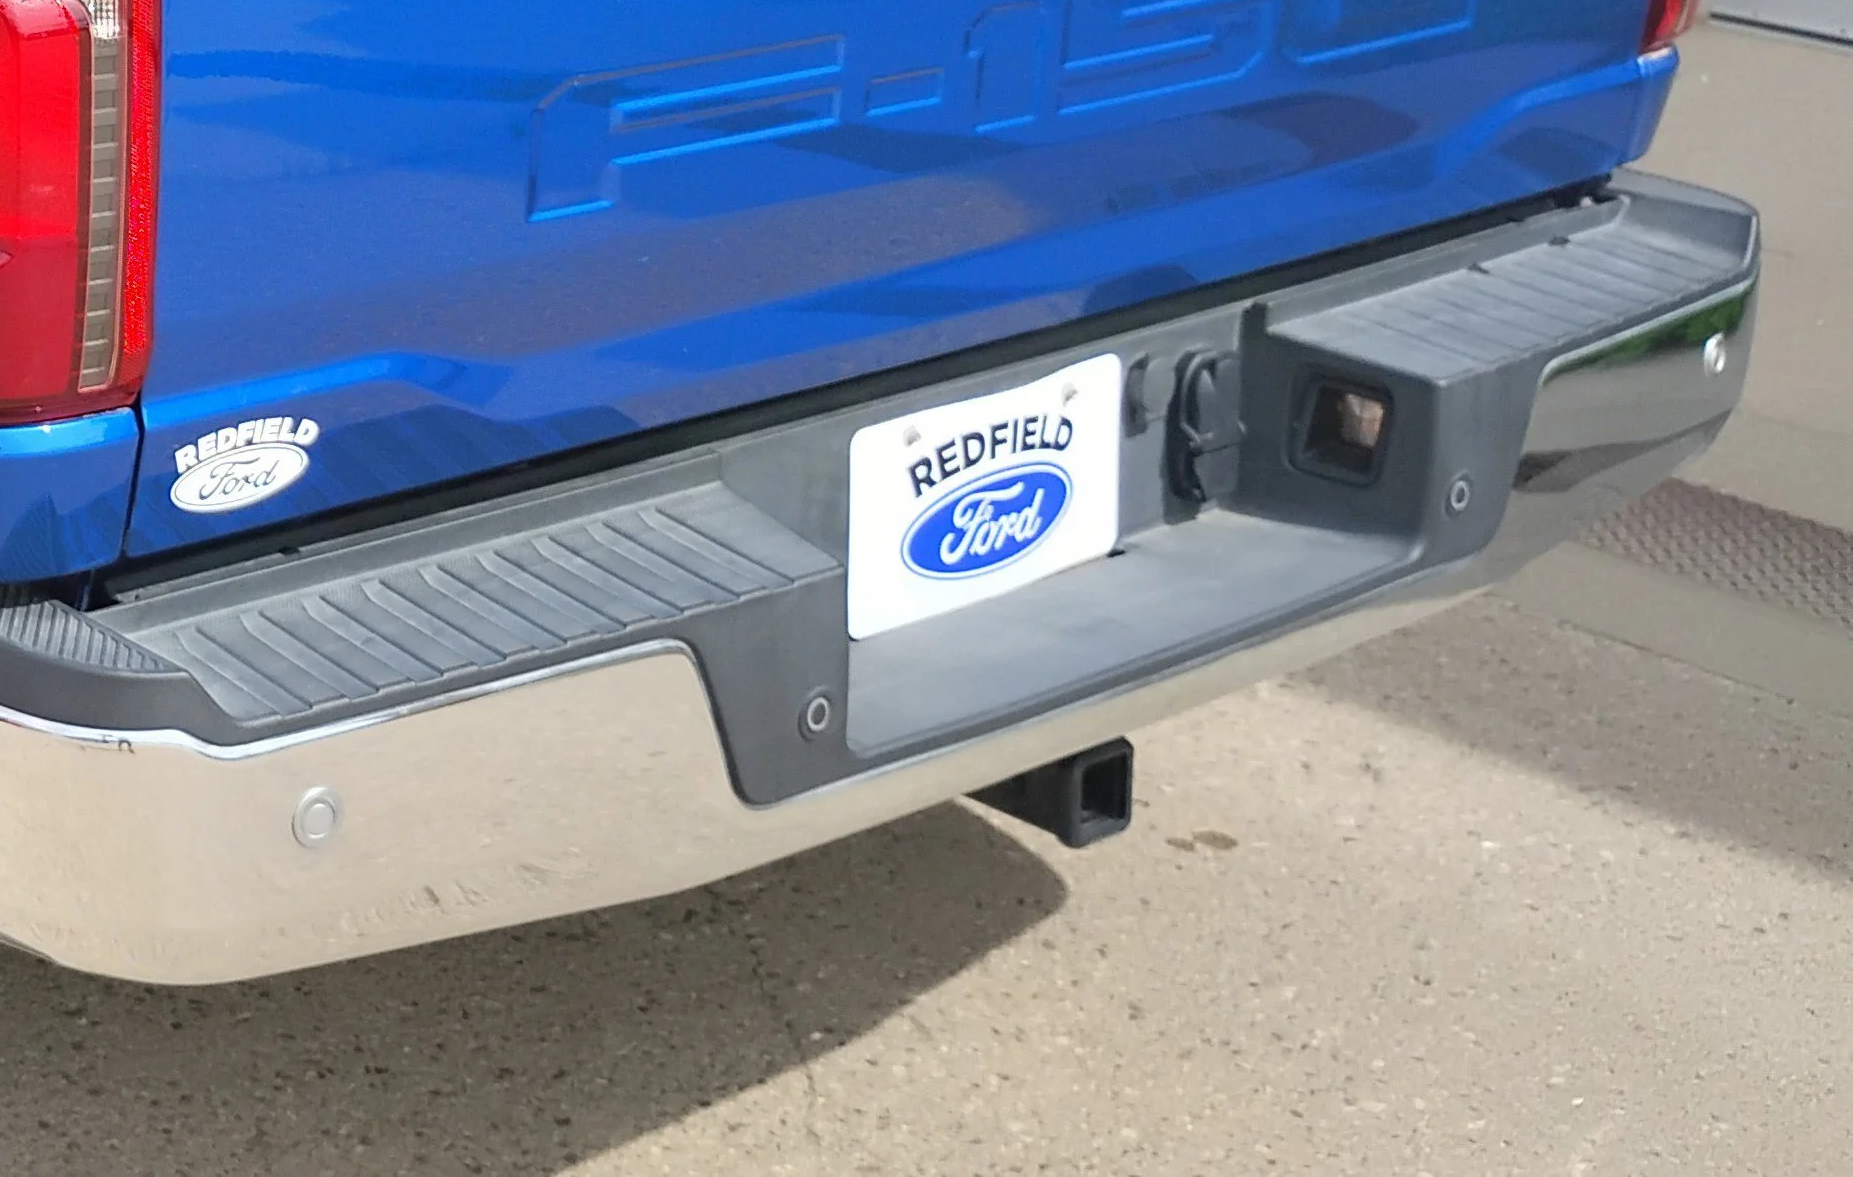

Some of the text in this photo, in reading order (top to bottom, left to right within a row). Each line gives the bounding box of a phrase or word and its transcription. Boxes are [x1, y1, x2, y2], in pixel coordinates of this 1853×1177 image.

[174, 416, 321, 475] REDFIELD
[198, 456, 280, 501] Ford
[905, 414, 1074, 498] REDFIELD
[939, 481, 1045, 565] Ford
